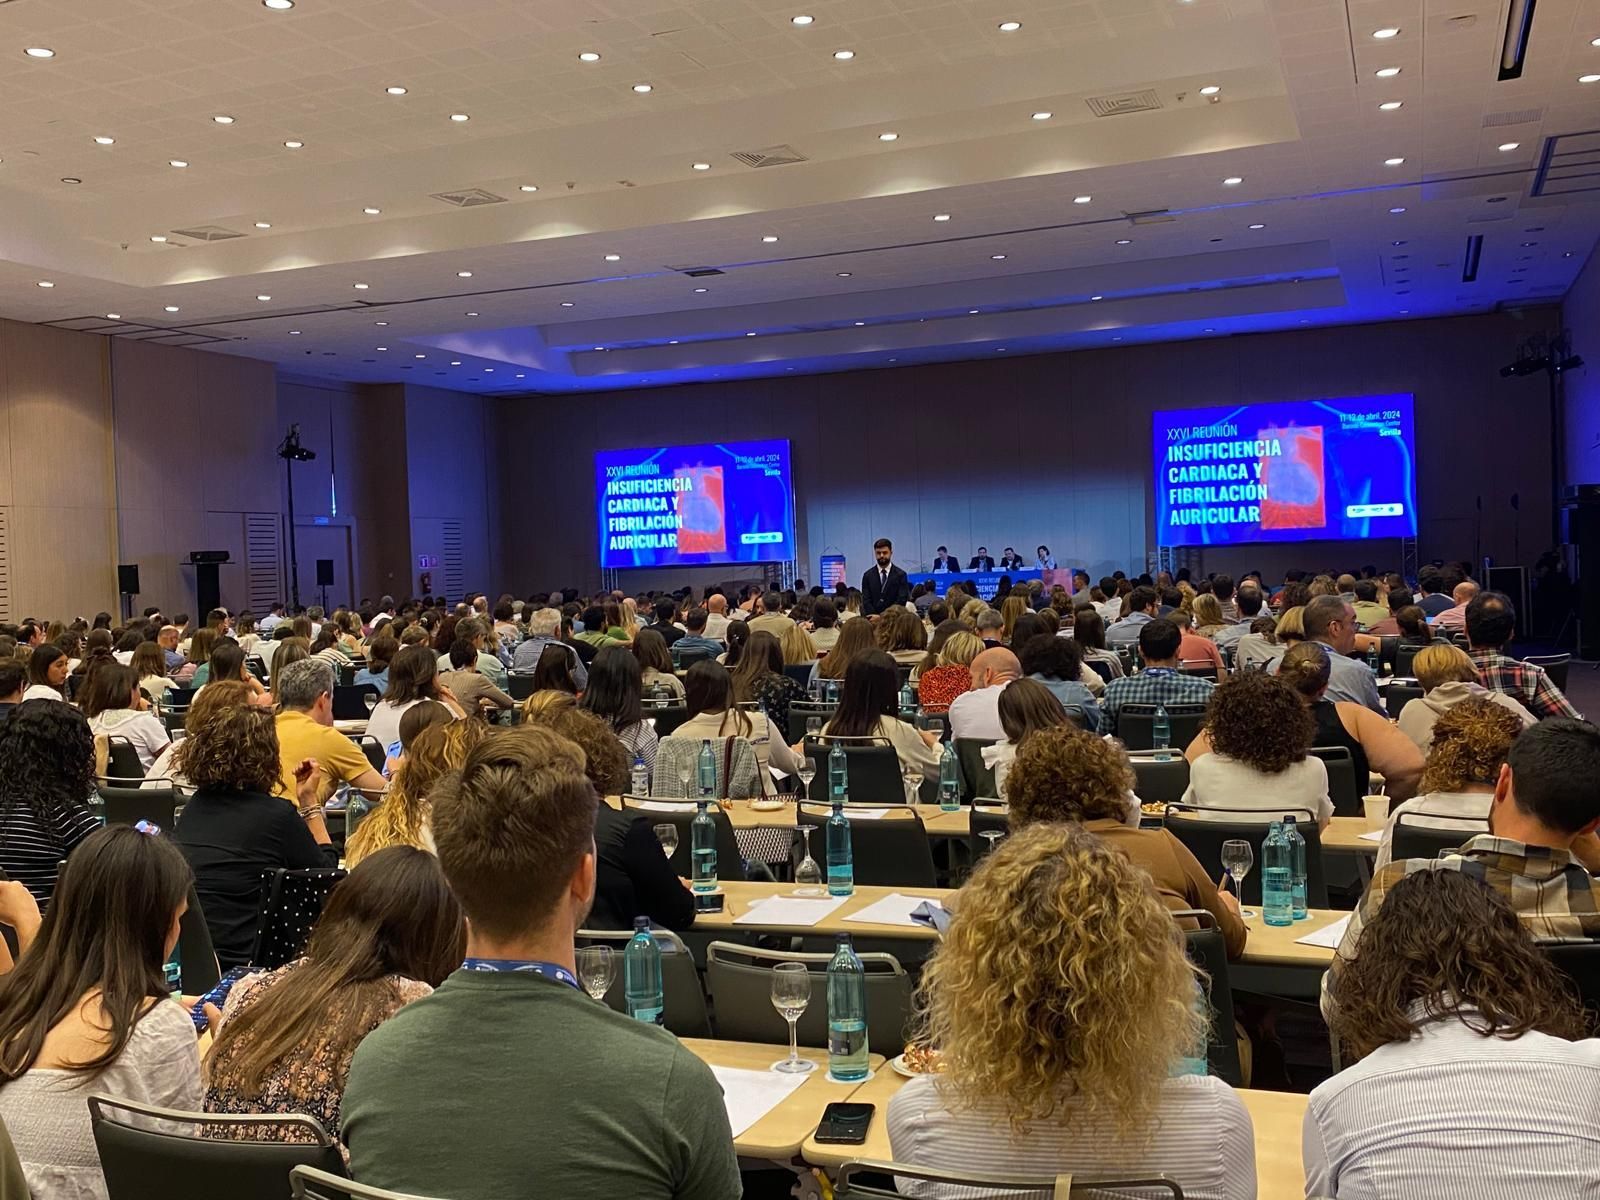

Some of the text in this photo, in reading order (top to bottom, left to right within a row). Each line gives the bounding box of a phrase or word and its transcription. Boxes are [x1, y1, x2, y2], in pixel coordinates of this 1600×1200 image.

[1382, 410, 1400, 420] 2024
[1167, 422, 1238, 440] XXVI REUNIÓN
[766, 453, 780, 462] 2024
[1168, 439, 1282, 462] INSUFICIENCIA
[606, 461, 660, 477] XXVI REUNIÓN
[1168, 462, 1263, 483] CARDIACA Y
[607, 477, 693, 495] INSUFICIENCIA
[1169, 480, 1268, 505] FIBRILACIÓN
[608, 496, 679, 513] CARDIACA Y
[609, 511, 683, 532] FIBRILACIÓN
[1170, 505, 1260, 526] AURICULAR
[610, 533, 678, 550] AURICULAR
